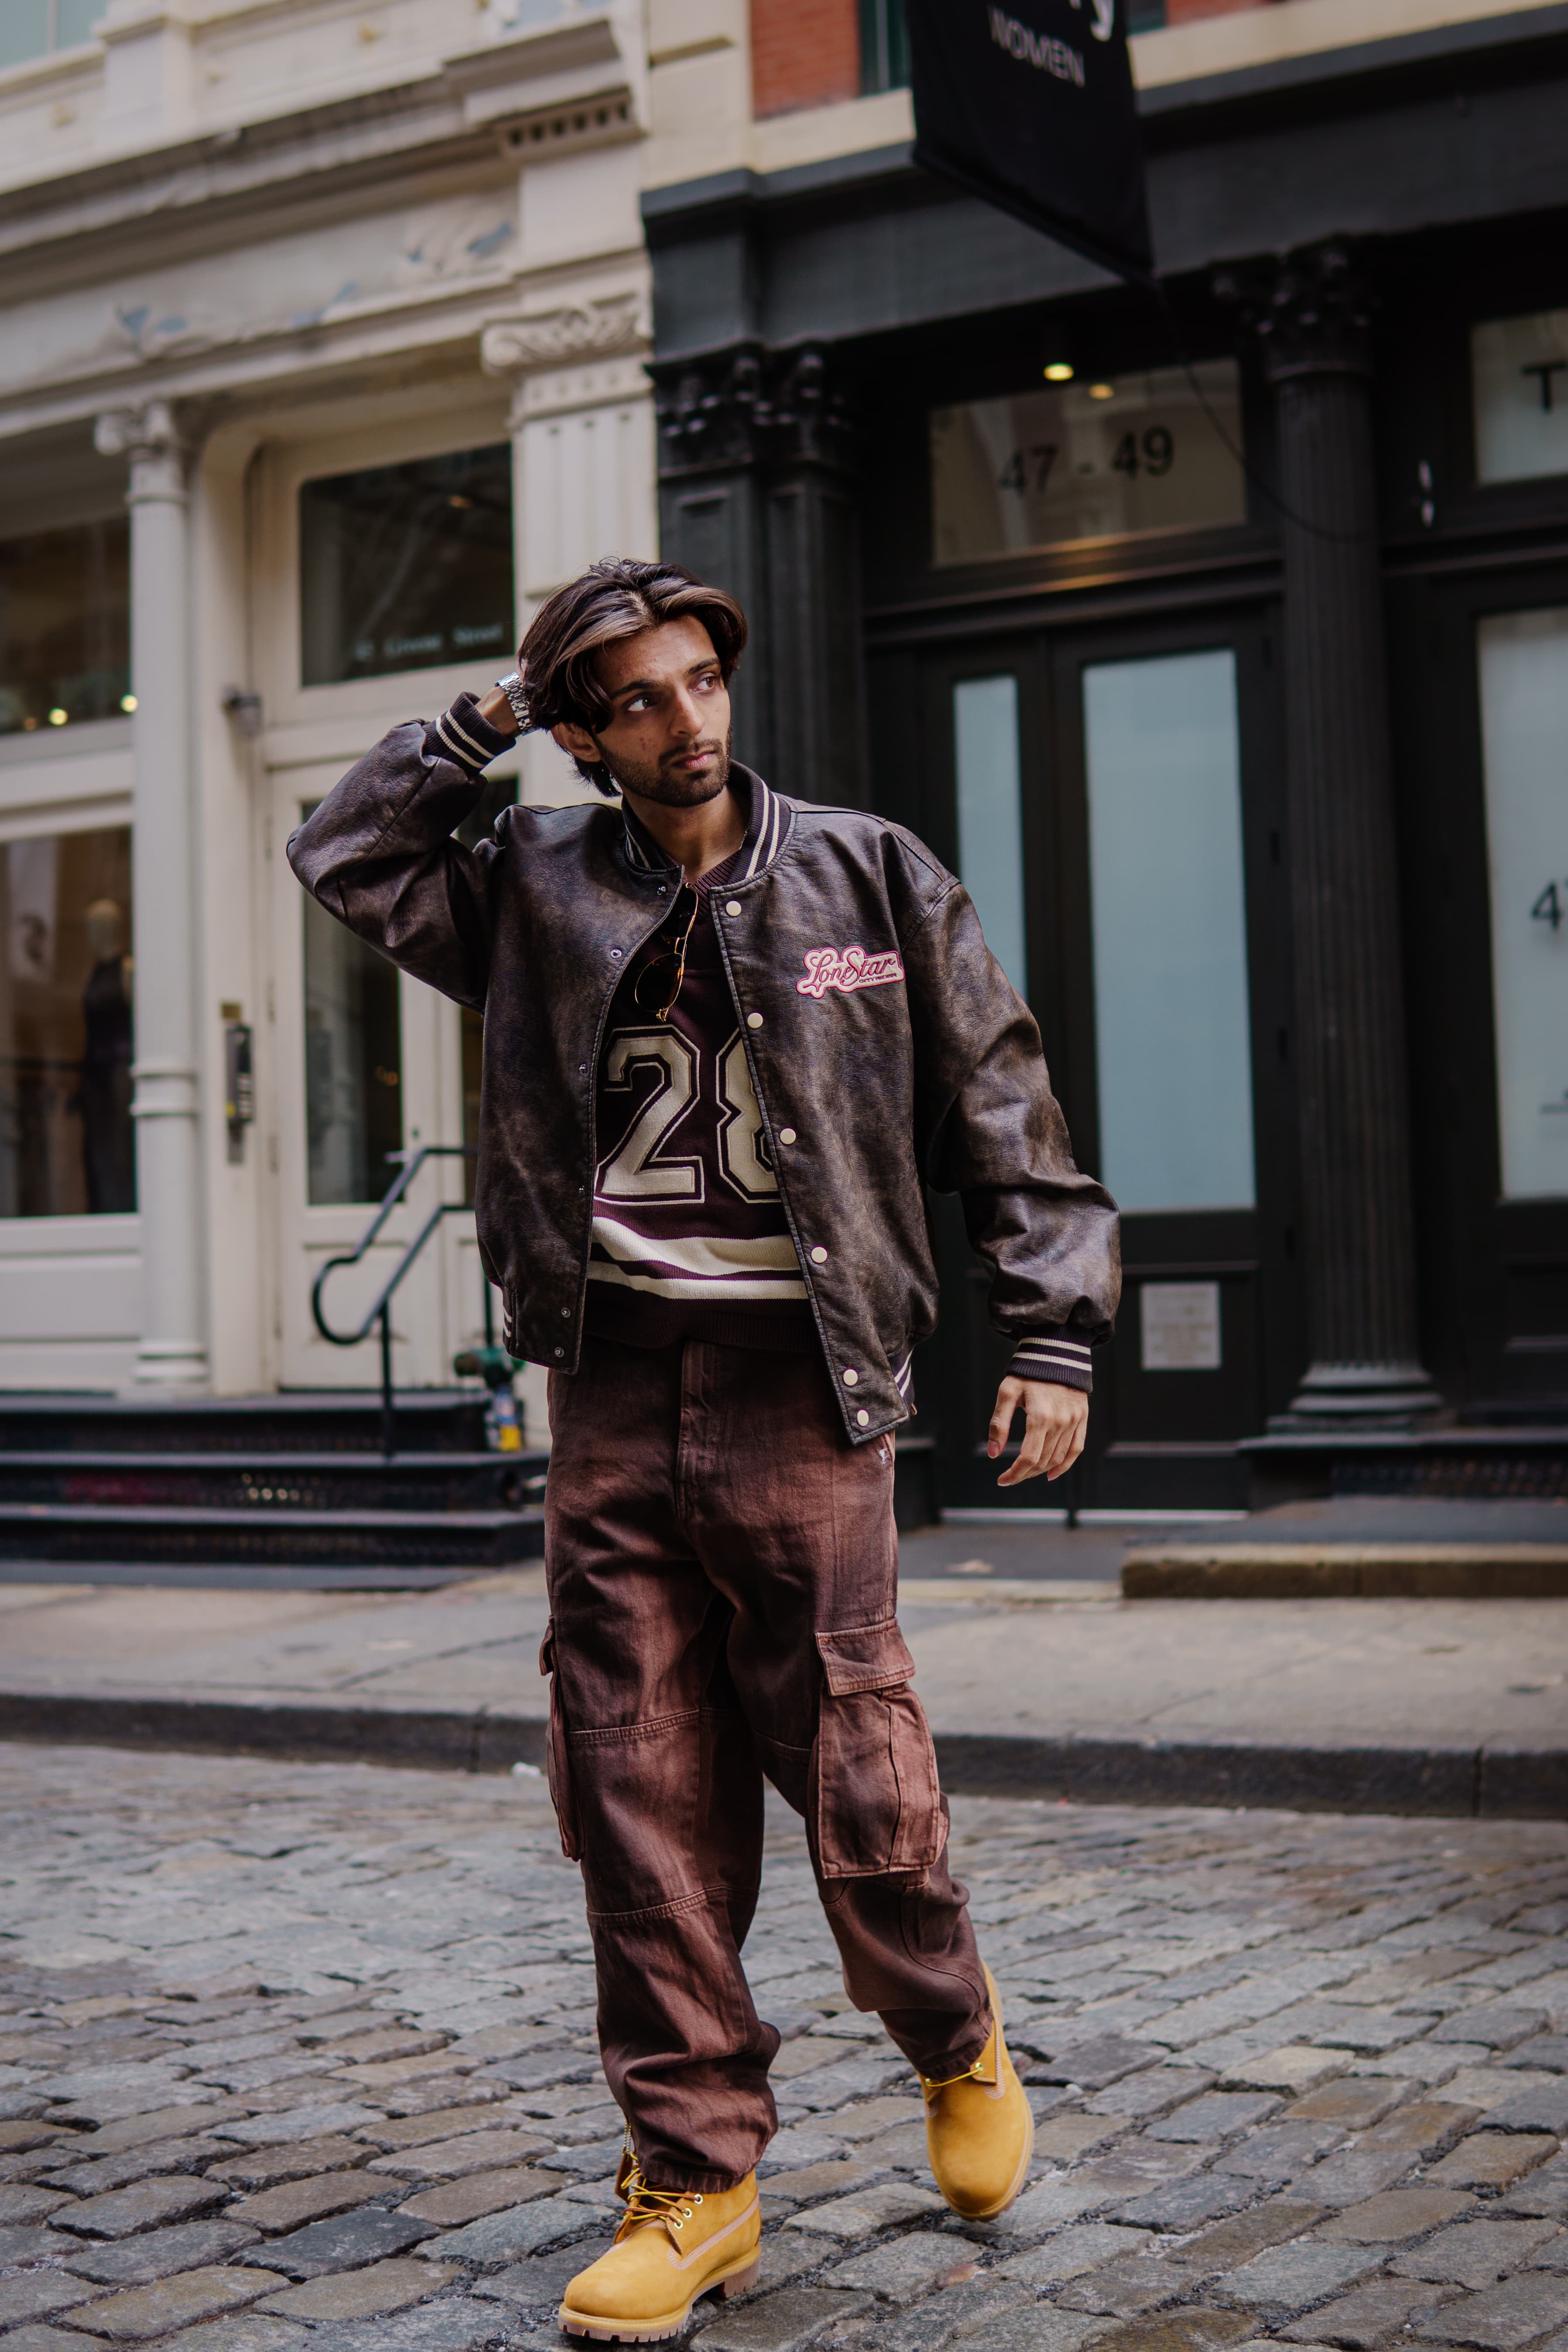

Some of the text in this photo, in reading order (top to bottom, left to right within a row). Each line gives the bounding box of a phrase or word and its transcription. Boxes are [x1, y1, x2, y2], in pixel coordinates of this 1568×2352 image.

[987, 3, 1085, 87] WOMEN
[1000, 443, 1058, 495] 47
[1112, 426, 1174, 478] 49
[593, 1024, 784, 1205] 28
